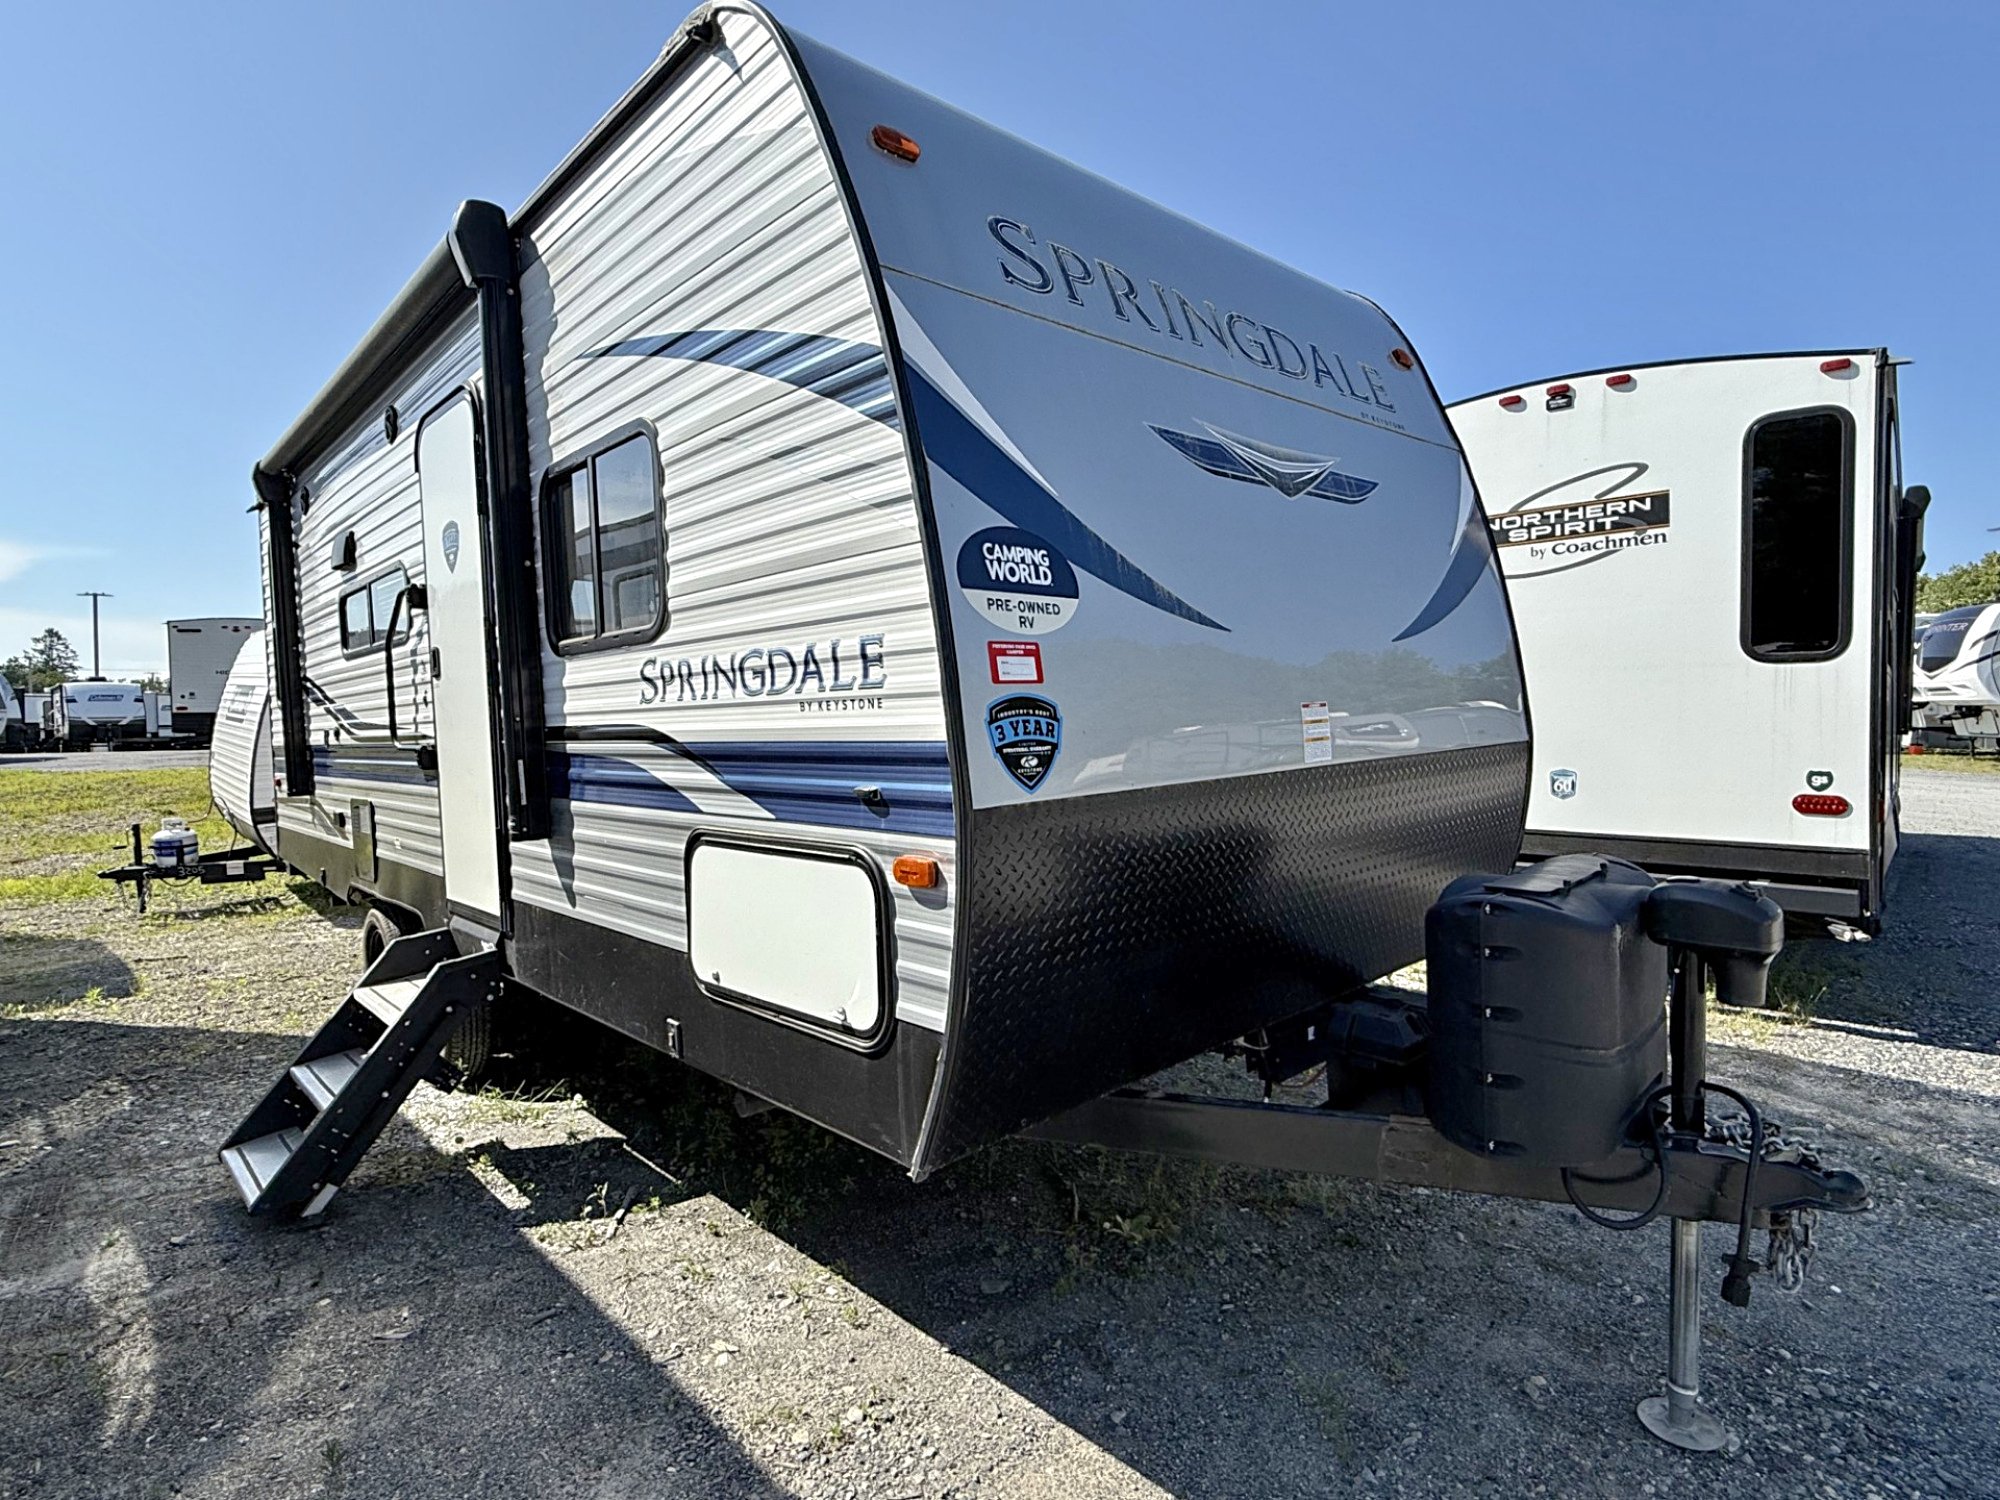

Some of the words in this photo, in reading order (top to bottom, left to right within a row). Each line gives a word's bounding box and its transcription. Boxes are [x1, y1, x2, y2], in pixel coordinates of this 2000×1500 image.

[987, 215, 1396, 414] SPRINGDALE
[1507, 516, 1620, 543] SPIRIT
[982, 542, 1050, 567] CAMPING
[1530, 547, 1547, 560] by
[1551, 532, 1669, 556] Coachmen
[984, 559, 1052, 587] WORLD
[986, 597, 1061, 616] PRE-OWNED
[1018, 615, 1035, 629] RV
[639, 633, 888, 705] SPRINGDALE
[799, 701, 812, 712] BY
[817, 697, 883, 712] KEYSTONE
[994, 724, 1006, 742] 3
[1008, 719, 1055, 739] YEAR
